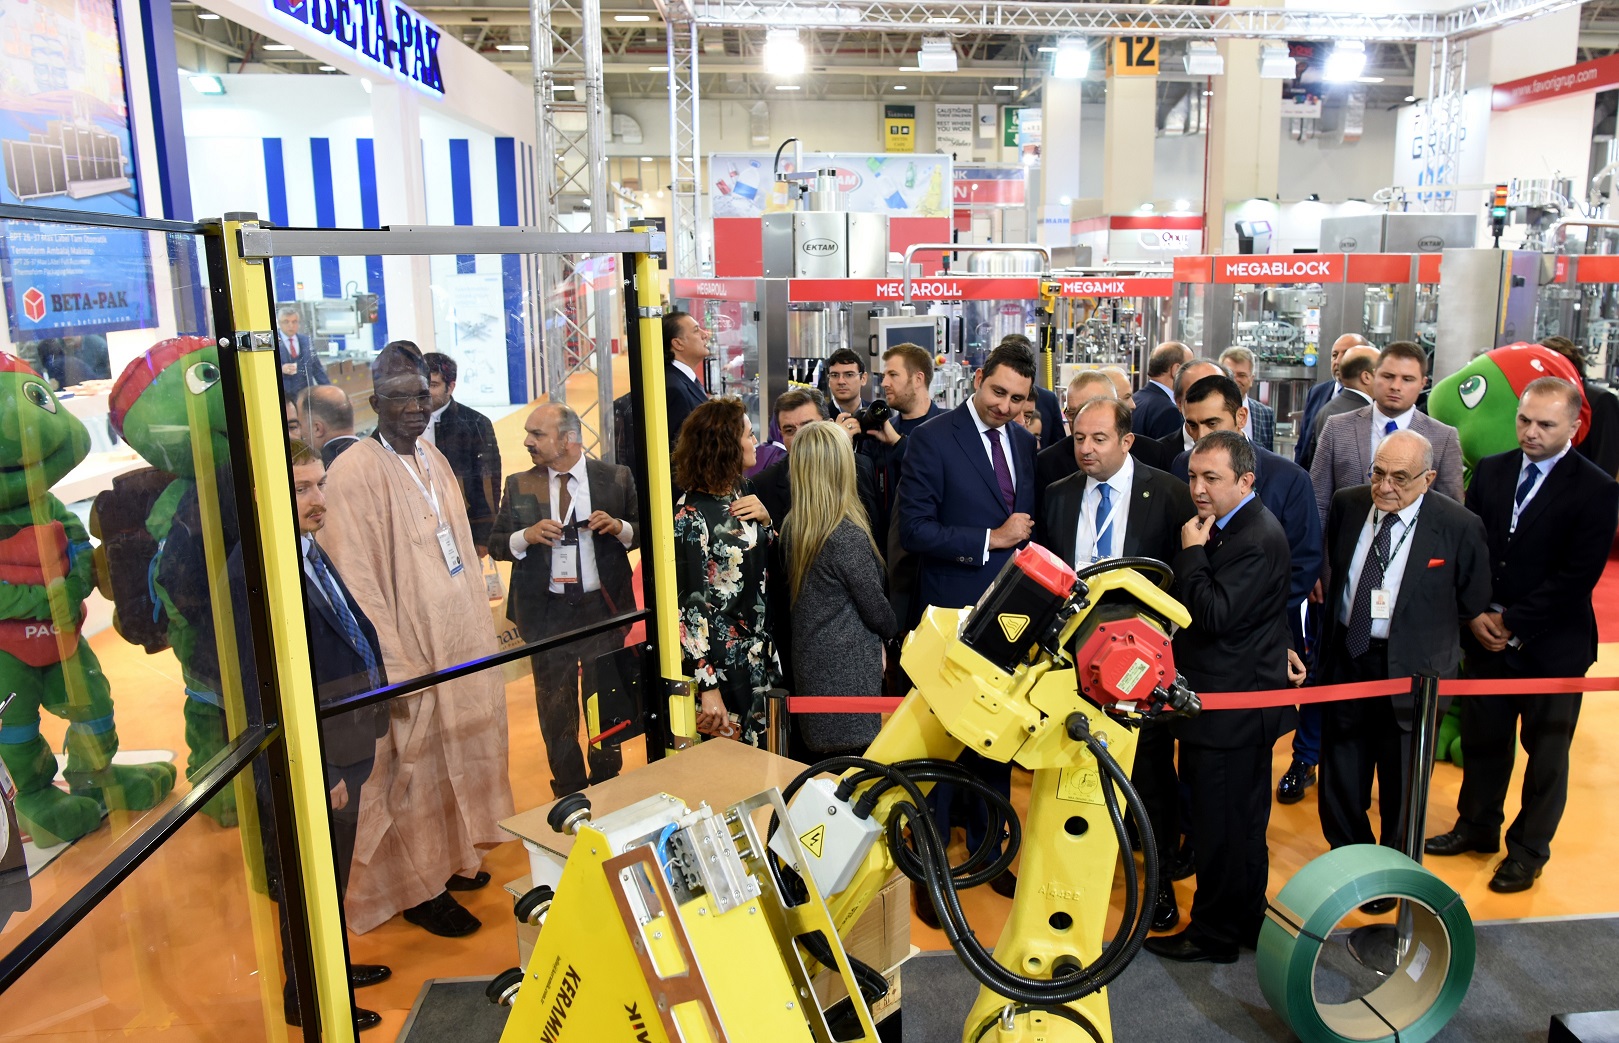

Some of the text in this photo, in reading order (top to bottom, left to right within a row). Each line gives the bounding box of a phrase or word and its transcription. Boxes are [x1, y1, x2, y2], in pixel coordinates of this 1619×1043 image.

[1119, 36, 1155, 66] 12
[1226, 261, 1330, 277] MEGABLOCK
[696, 283, 727, 297] MEGAROLL
[1063, 281, 1125, 294] MEGAMIX
[51, 291, 129, 313] BETA-PAK
